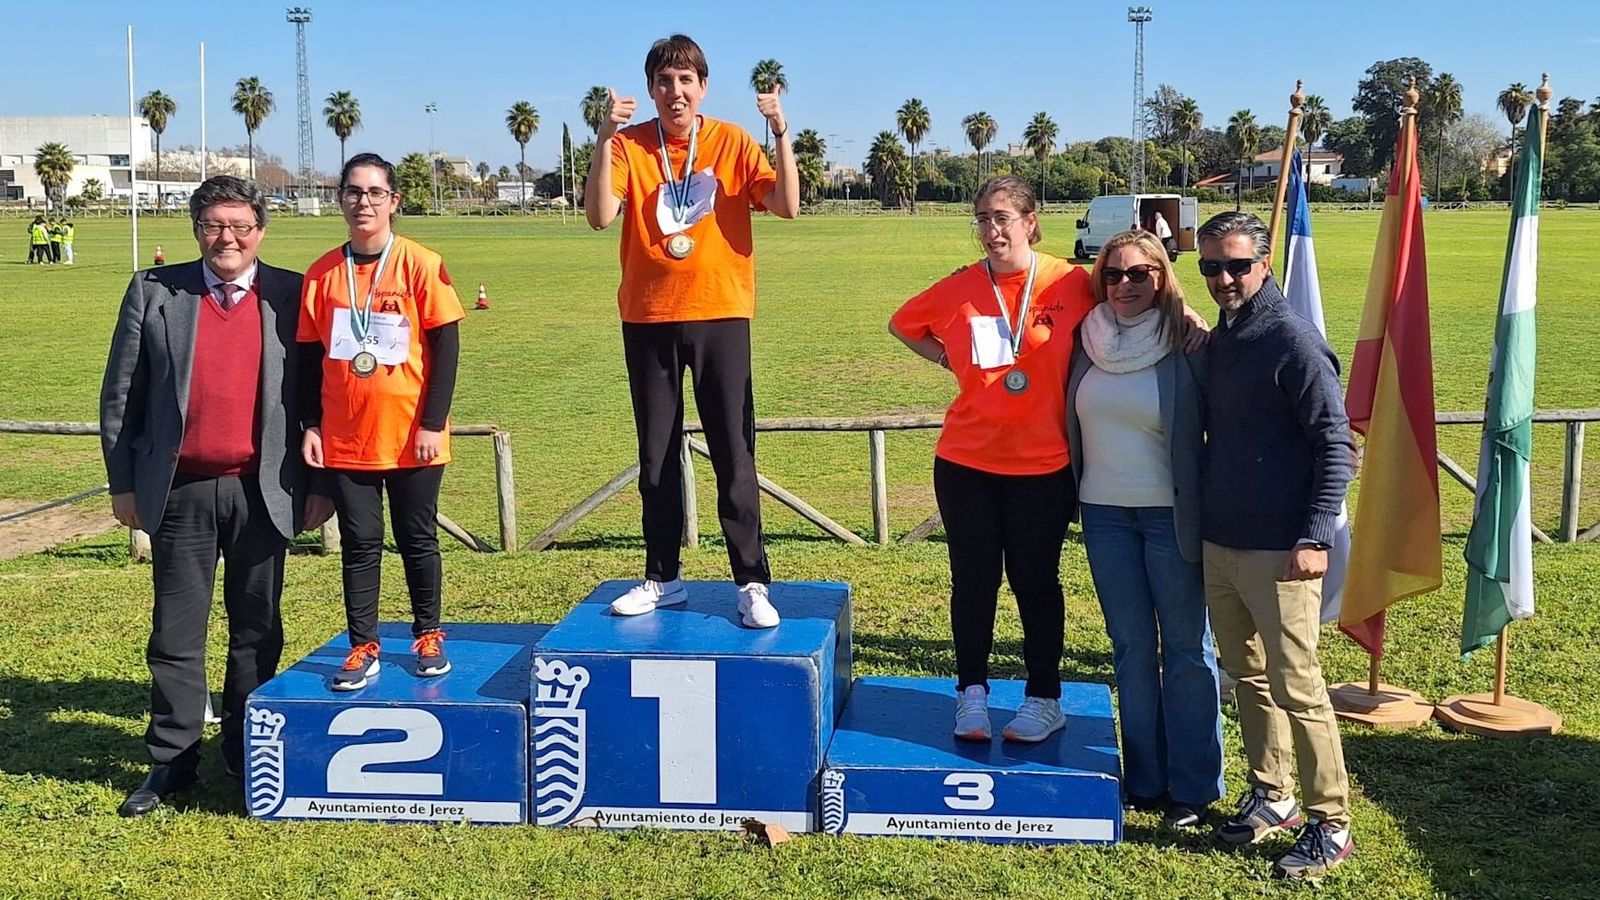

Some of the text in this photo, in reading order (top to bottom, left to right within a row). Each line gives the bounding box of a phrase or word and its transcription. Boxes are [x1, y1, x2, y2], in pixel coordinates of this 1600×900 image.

[630, 659, 717, 804] 1
[326, 706, 444, 796] 2
[943, 772, 995, 811] 3
[308, 800, 465, 817] Ayuntamiento de Jerez
[595, 810, 695, 824] Ayuntamiento
[699, 812, 716, 824] de
[886, 817, 1054, 834] Ayuntamiento de Jerez
